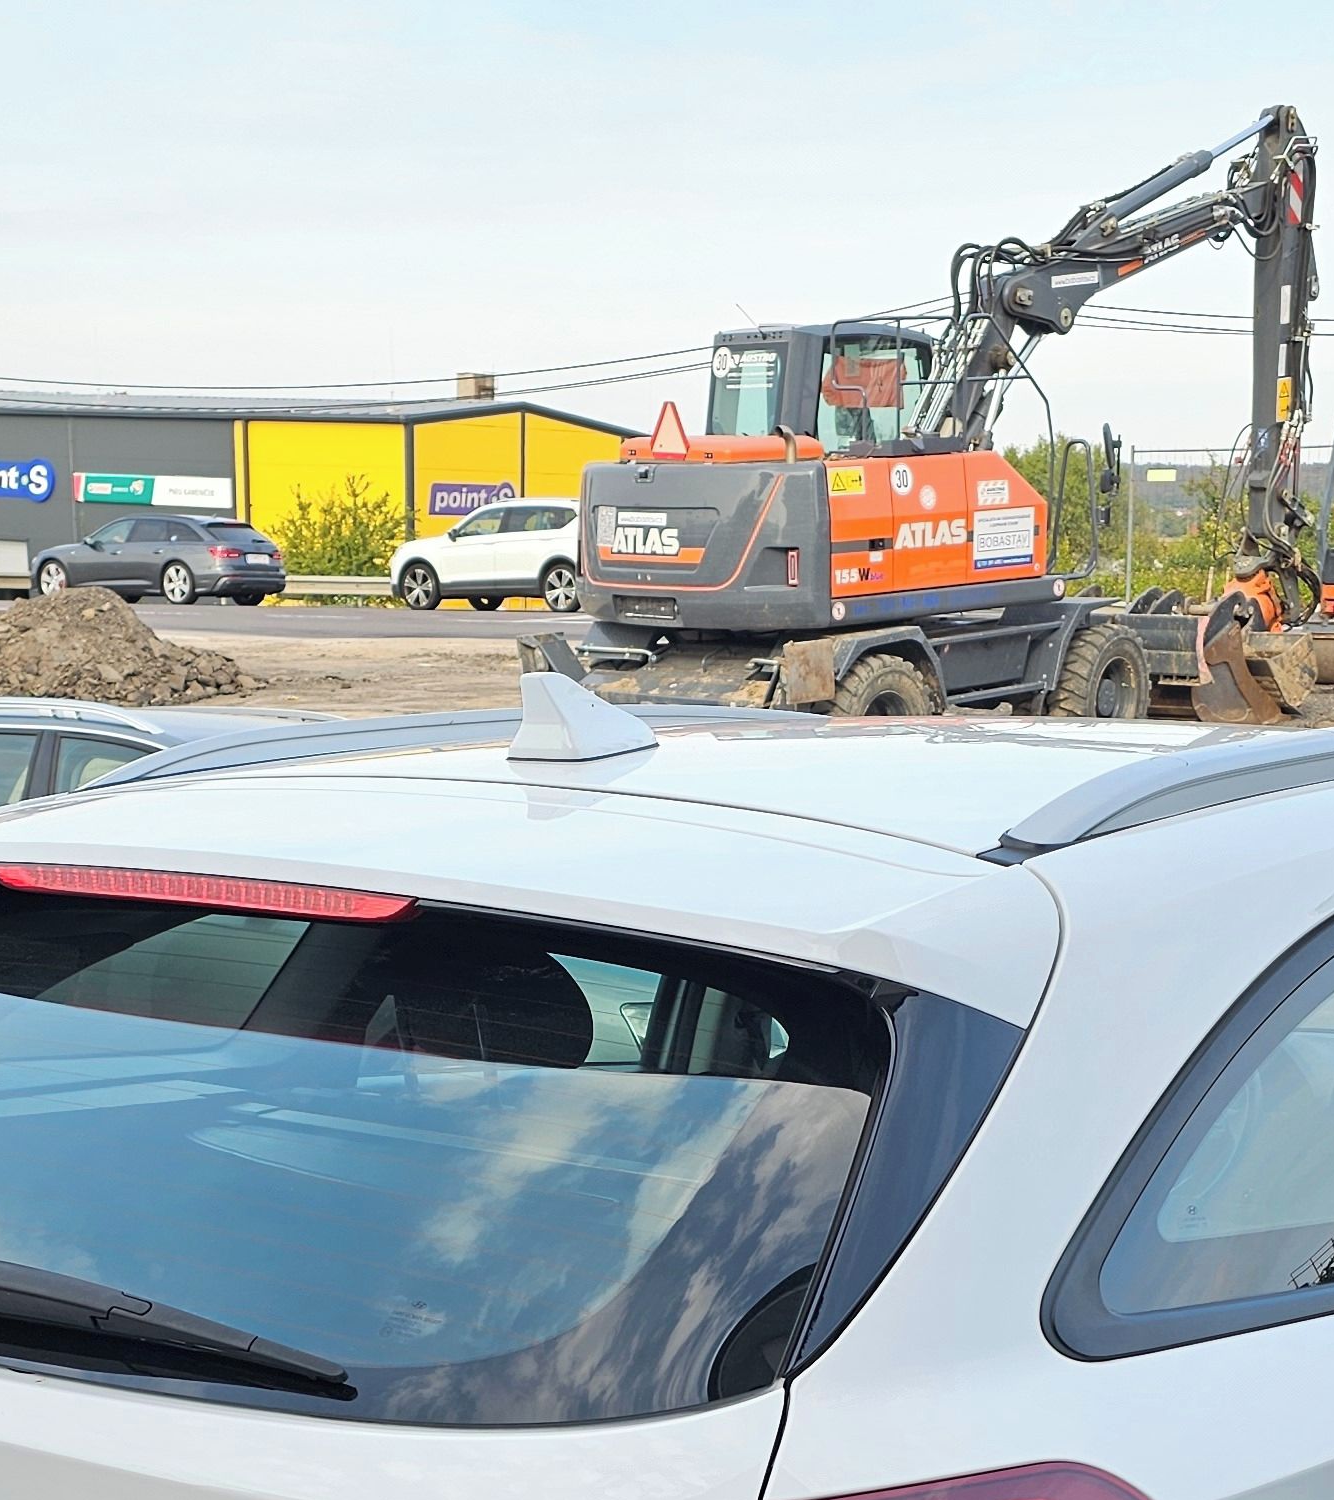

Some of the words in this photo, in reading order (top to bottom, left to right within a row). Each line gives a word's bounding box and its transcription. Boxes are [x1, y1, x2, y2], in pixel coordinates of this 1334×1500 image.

[716, 354, 728, 371] 30
[895, 469, 909, 488] 30
[611, 527, 680, 555] ATLAS
[894, 518, 967, 550] ATLAS
